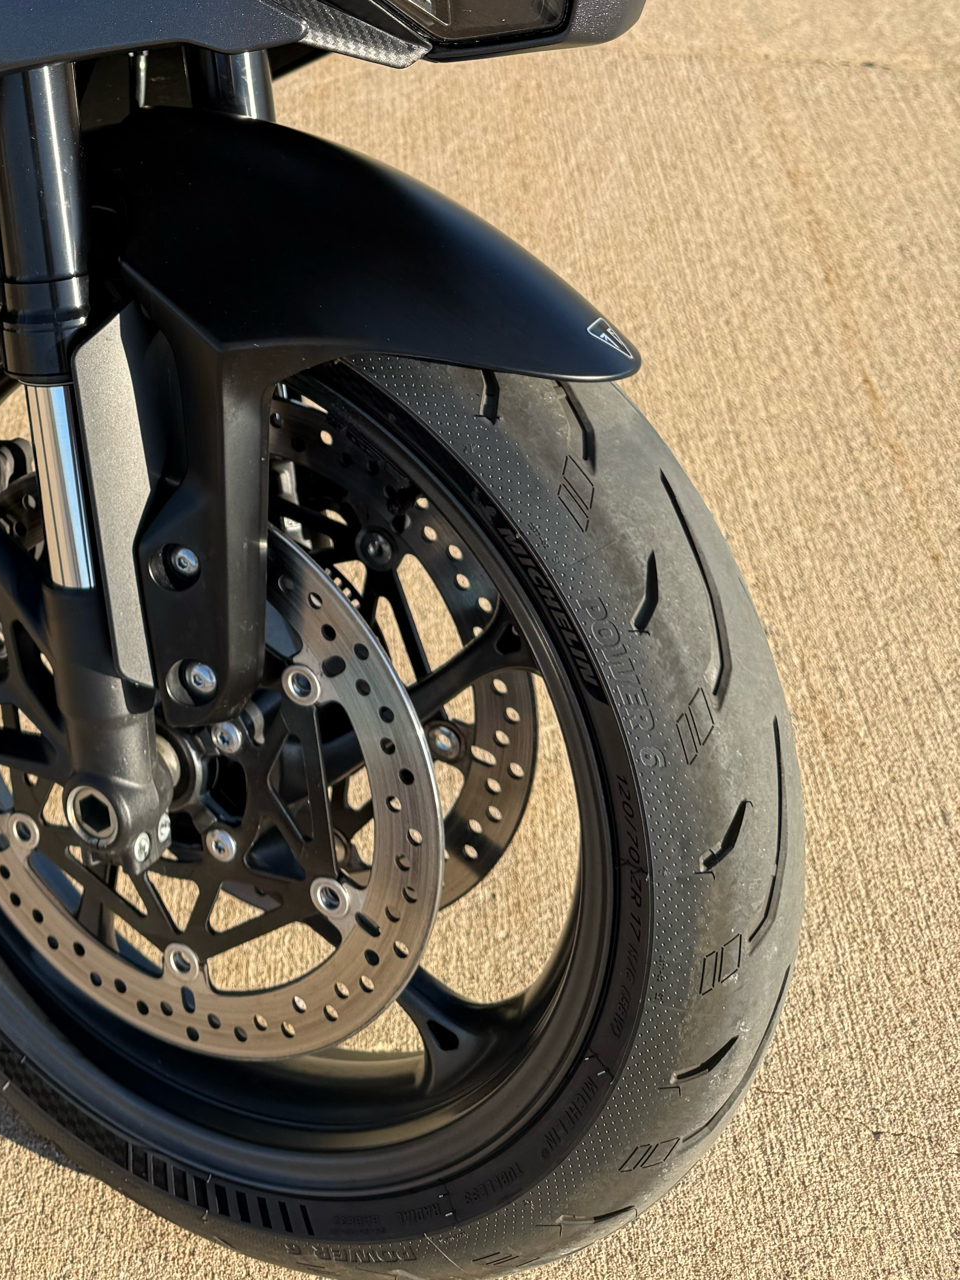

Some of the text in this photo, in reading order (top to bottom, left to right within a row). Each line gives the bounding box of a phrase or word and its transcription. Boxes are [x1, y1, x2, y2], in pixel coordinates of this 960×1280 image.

[500, 527, 599, 688] MICHELIN
[575, 596, 667, 769] POWER 6
[617, 775, 641, 864] 120/70
[630, 912, 642, 942] 17
[312, 1245, 418, 1263] POWER
[396, 1162, 523, 1225] TUBELESS RADIAL
